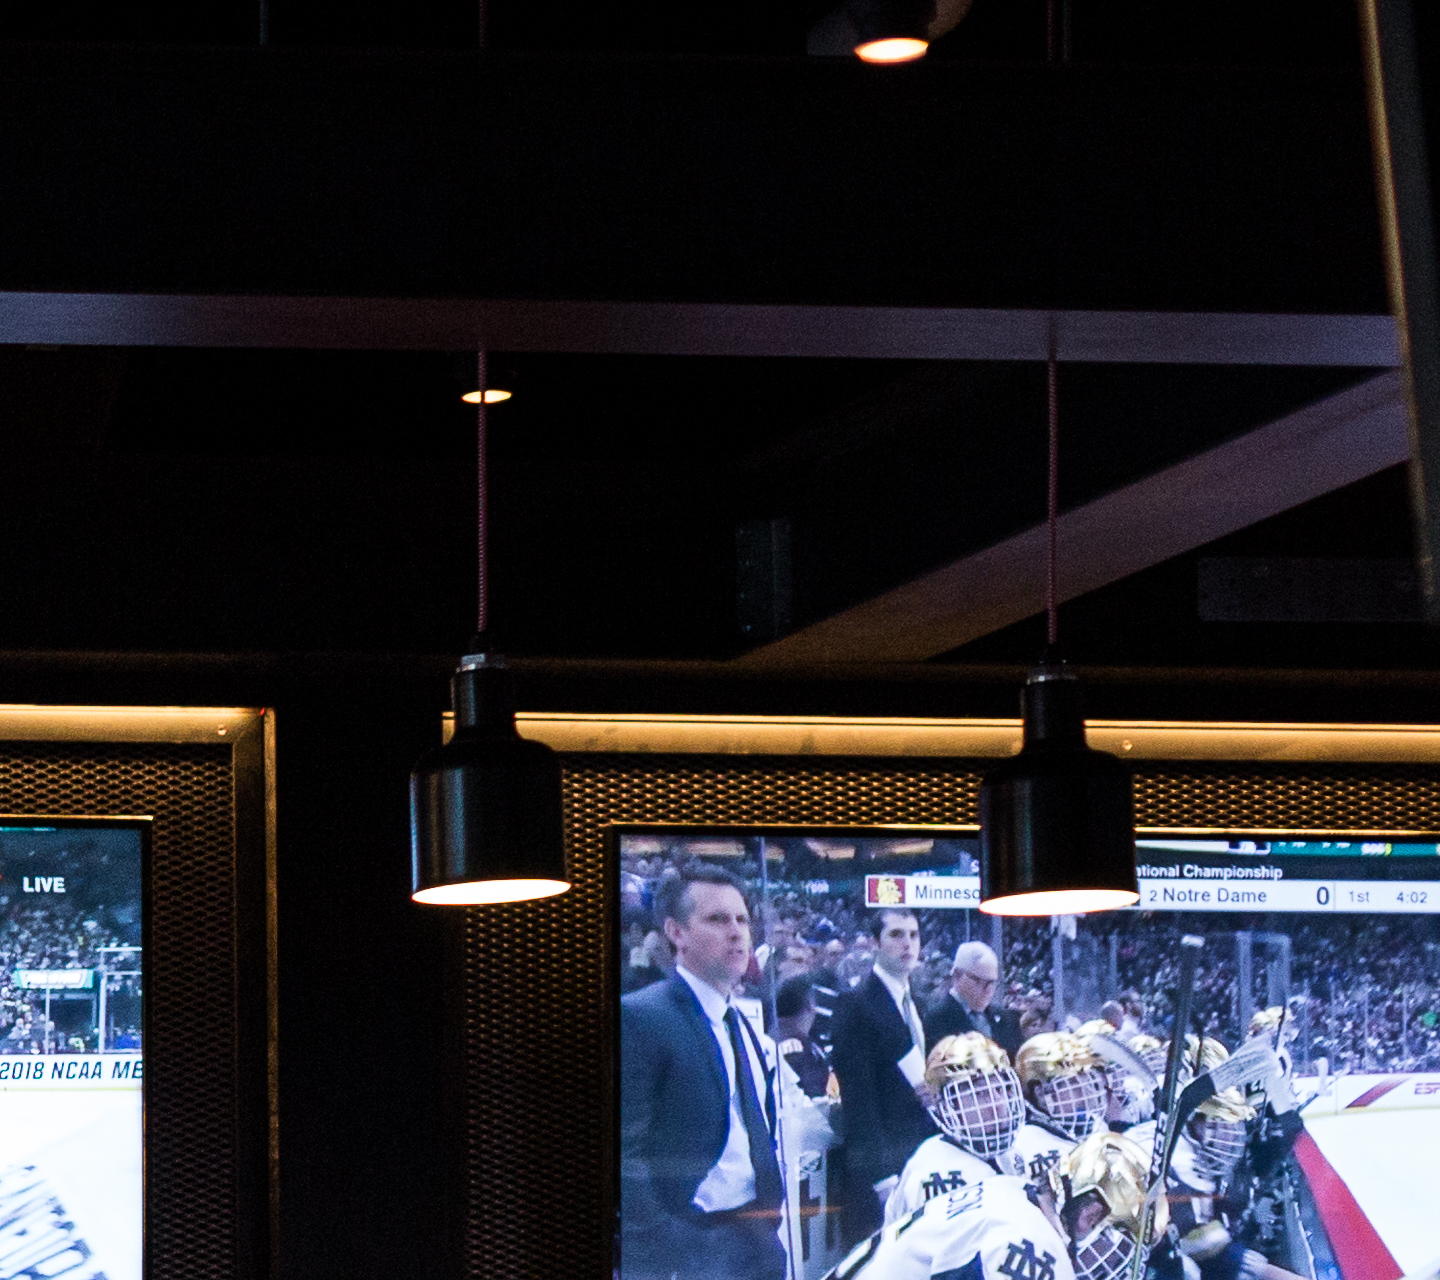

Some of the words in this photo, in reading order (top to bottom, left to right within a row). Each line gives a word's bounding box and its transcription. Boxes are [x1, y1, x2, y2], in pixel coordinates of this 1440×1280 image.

[1136, 864, 1180, 878] ational
[1182, 864, 1284, 881] Championship
[22, 876, 66, 894] LIVE
[915, 884, 980, 900] Minneso
[1150, 889, 1158, 902] 2
[1163, 887, 1211, 903] Notre
[1217, 887, 1268, 904] Dame
[1315, 886, 1330, 906] 0
[1349, 889, 1371, 904] 1st
[1395, 889, 1429, 904] 4:02
[51, 1061, 103, 1080] NCAA
